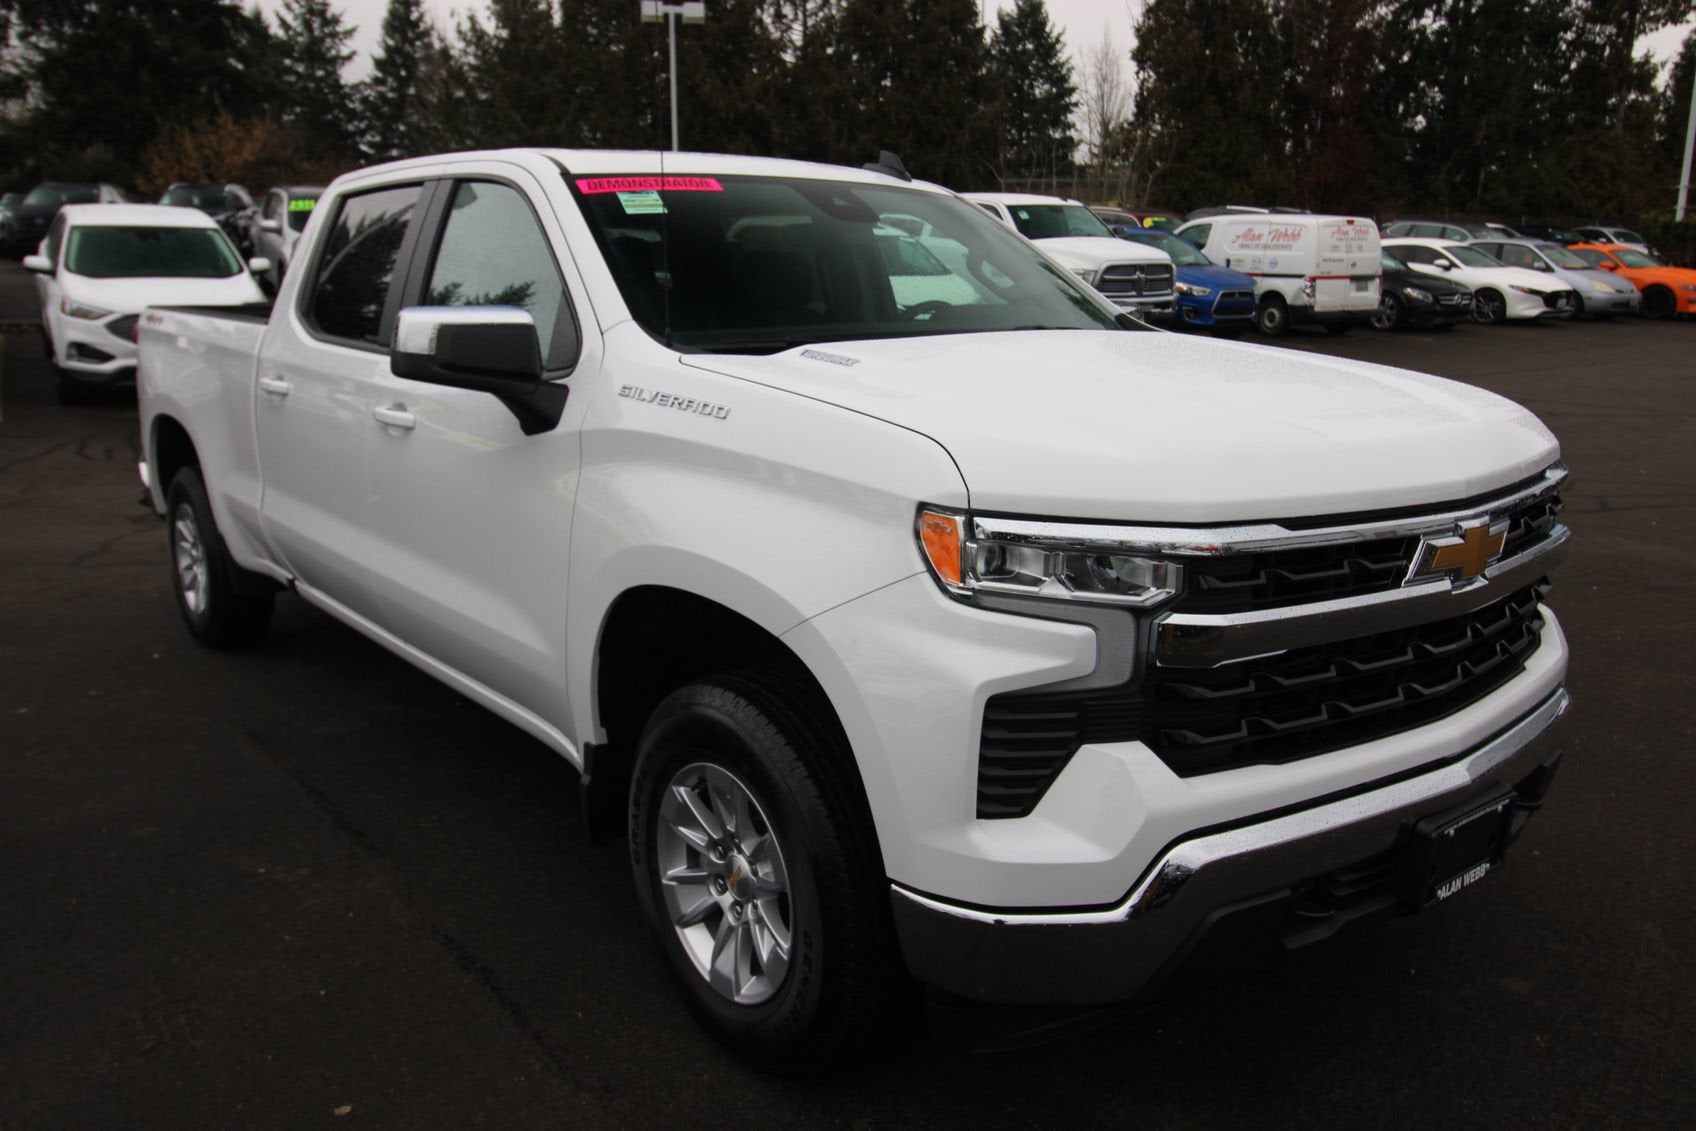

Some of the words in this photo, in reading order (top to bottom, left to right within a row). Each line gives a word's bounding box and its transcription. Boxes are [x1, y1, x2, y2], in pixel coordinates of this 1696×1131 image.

[586, 178, 713, 190] DEMONSTRATOR
[1231, 227, 1264, 244] Alan
[1268, 227, 1303, 243] Webb
[618, 384, 731, 420] SILVERADO
[1440, 876, 1463, 901] ALAN
[1463, 863, 1487, 887] WEBB
